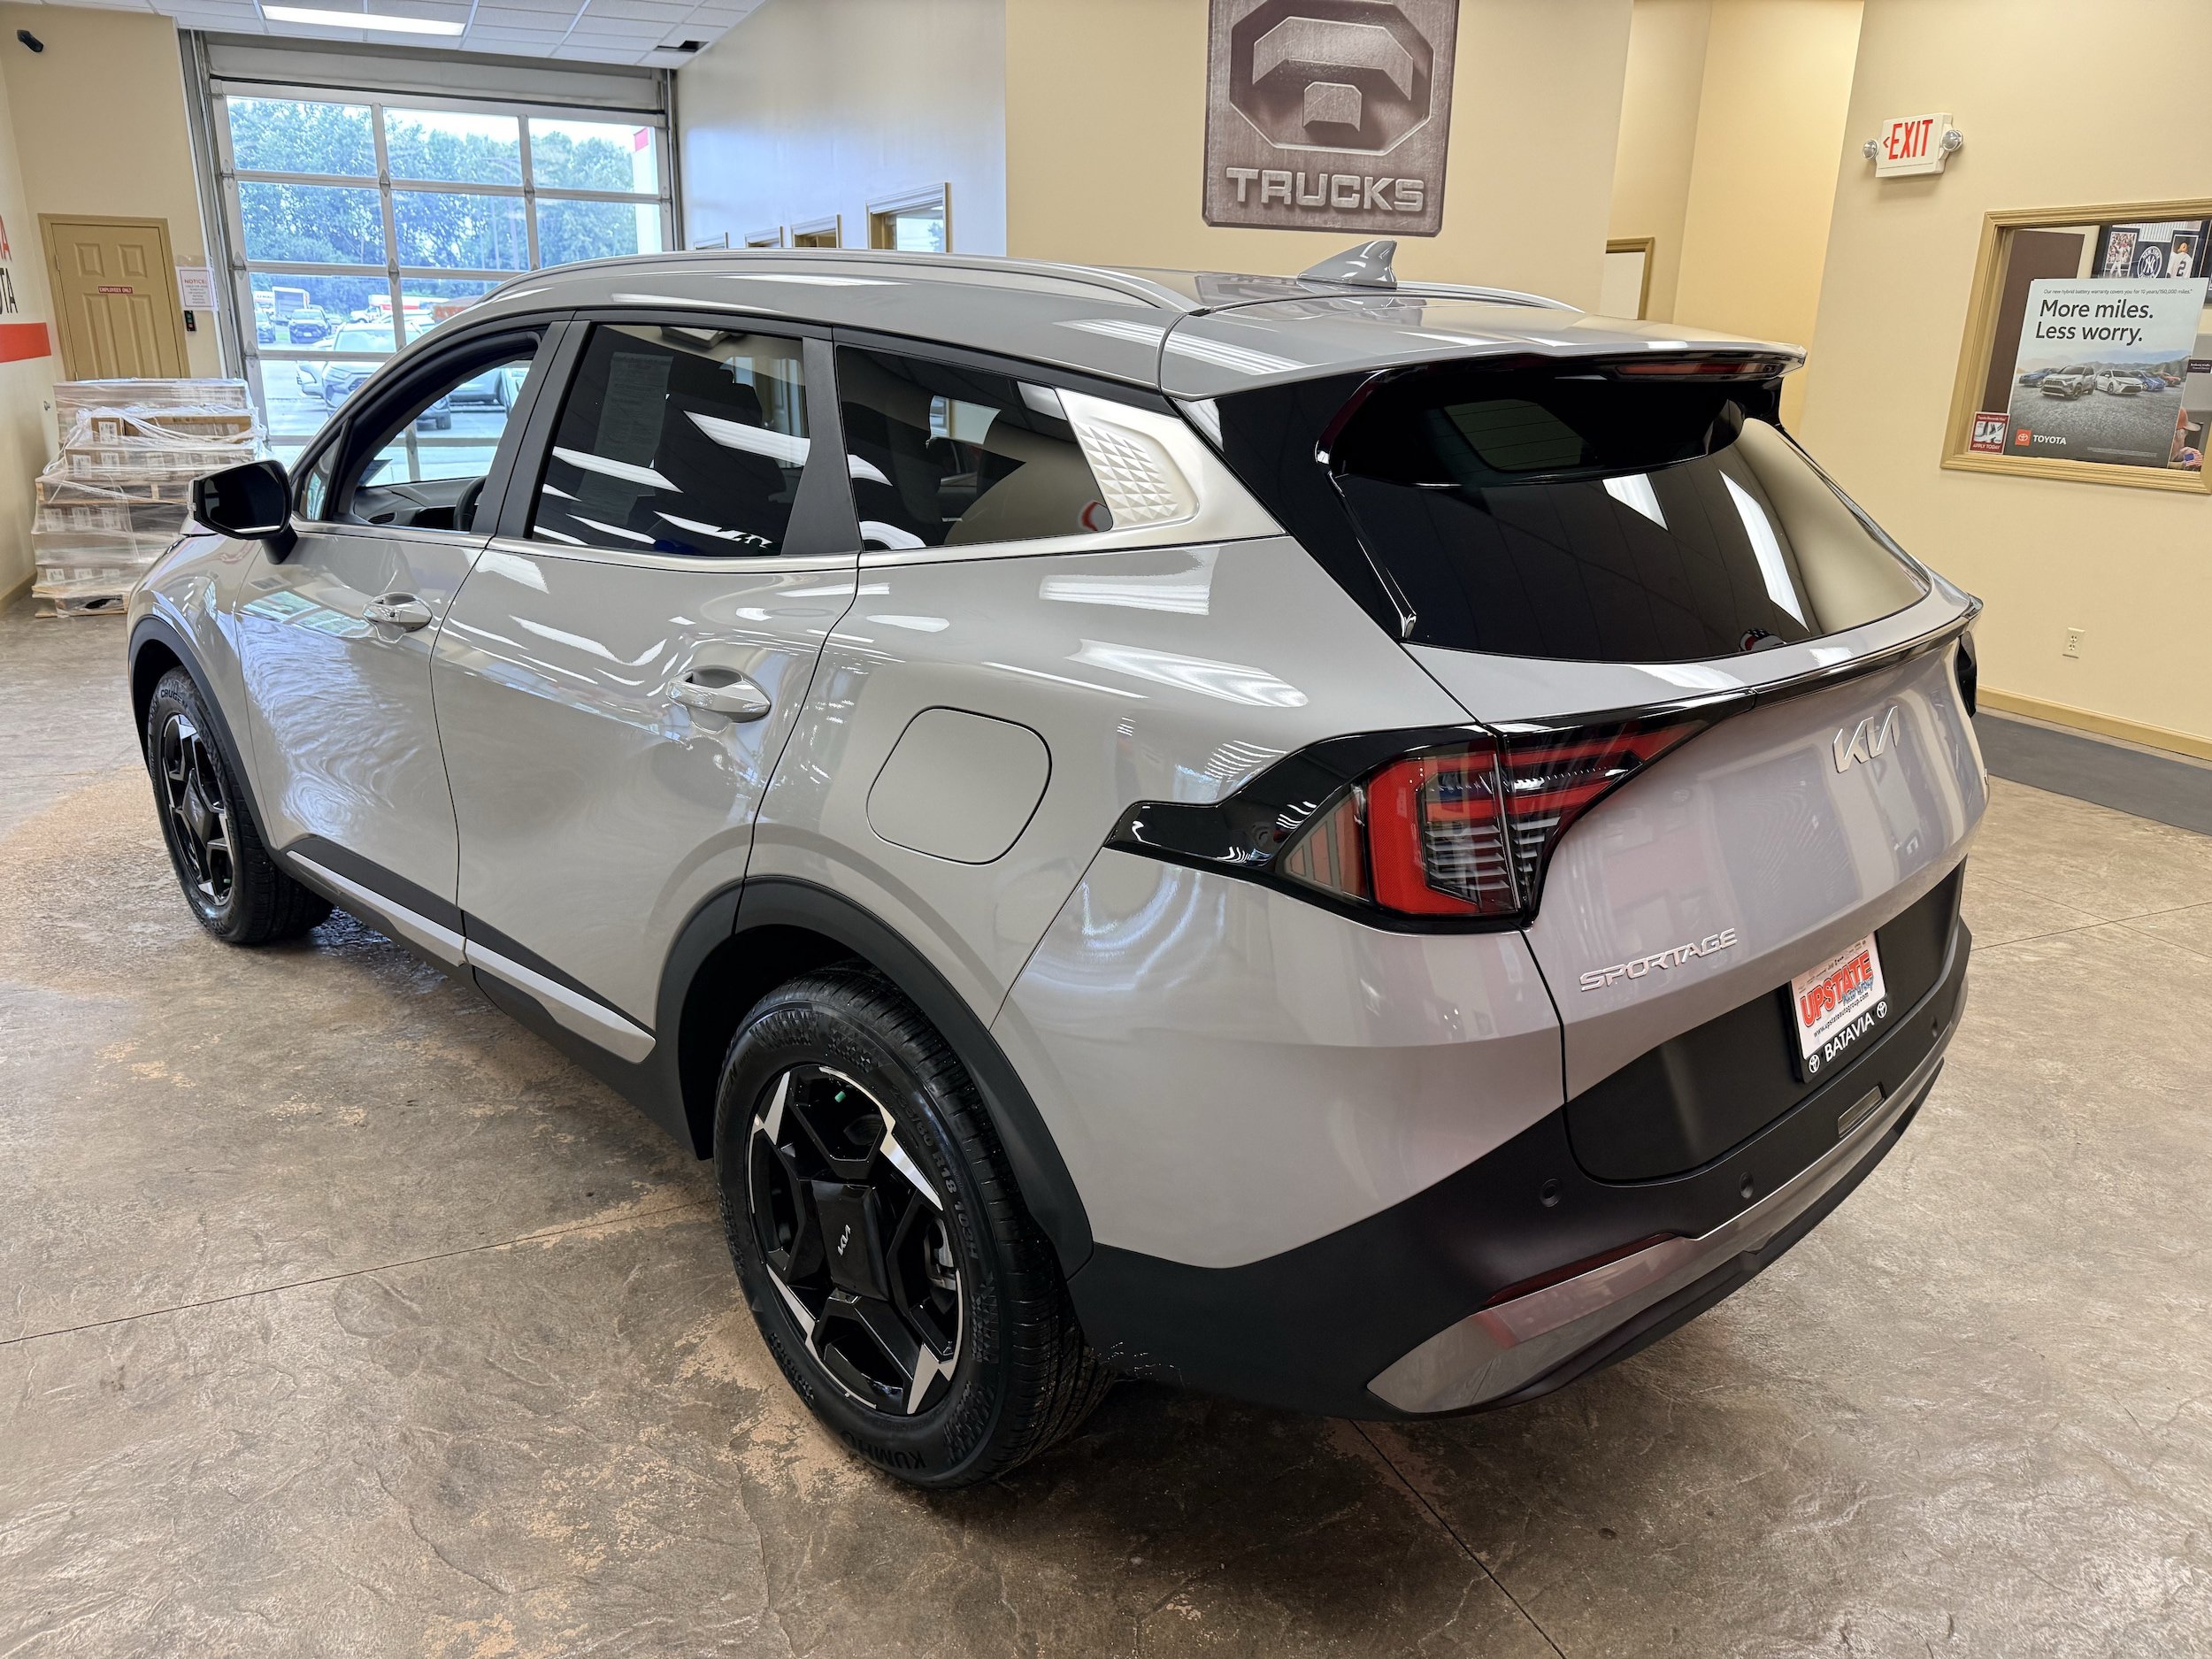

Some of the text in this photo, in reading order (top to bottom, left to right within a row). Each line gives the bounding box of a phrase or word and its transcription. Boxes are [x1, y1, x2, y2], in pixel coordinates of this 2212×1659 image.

[1888, 119, 1933, 160] EXIT
[1225, 167, 1425, 212] TRUCKS
[2176, 260, 2186, 277] 2
[2039, 298, 2154, 319] More miles.
[2035, 321, 2143, 346] Less worry.
[2032, 434, 2067, 445] TOYOTA
[1579, 927, 1738, 992] SPORTAGE
[1800, 949, 1874, 1027] UPSTATE
[1824, 1011, 1875, 1062] BATAVIA
[932, 1152, 957, 1194] R18
[841, 1431, 927, 1469] KUMHO
